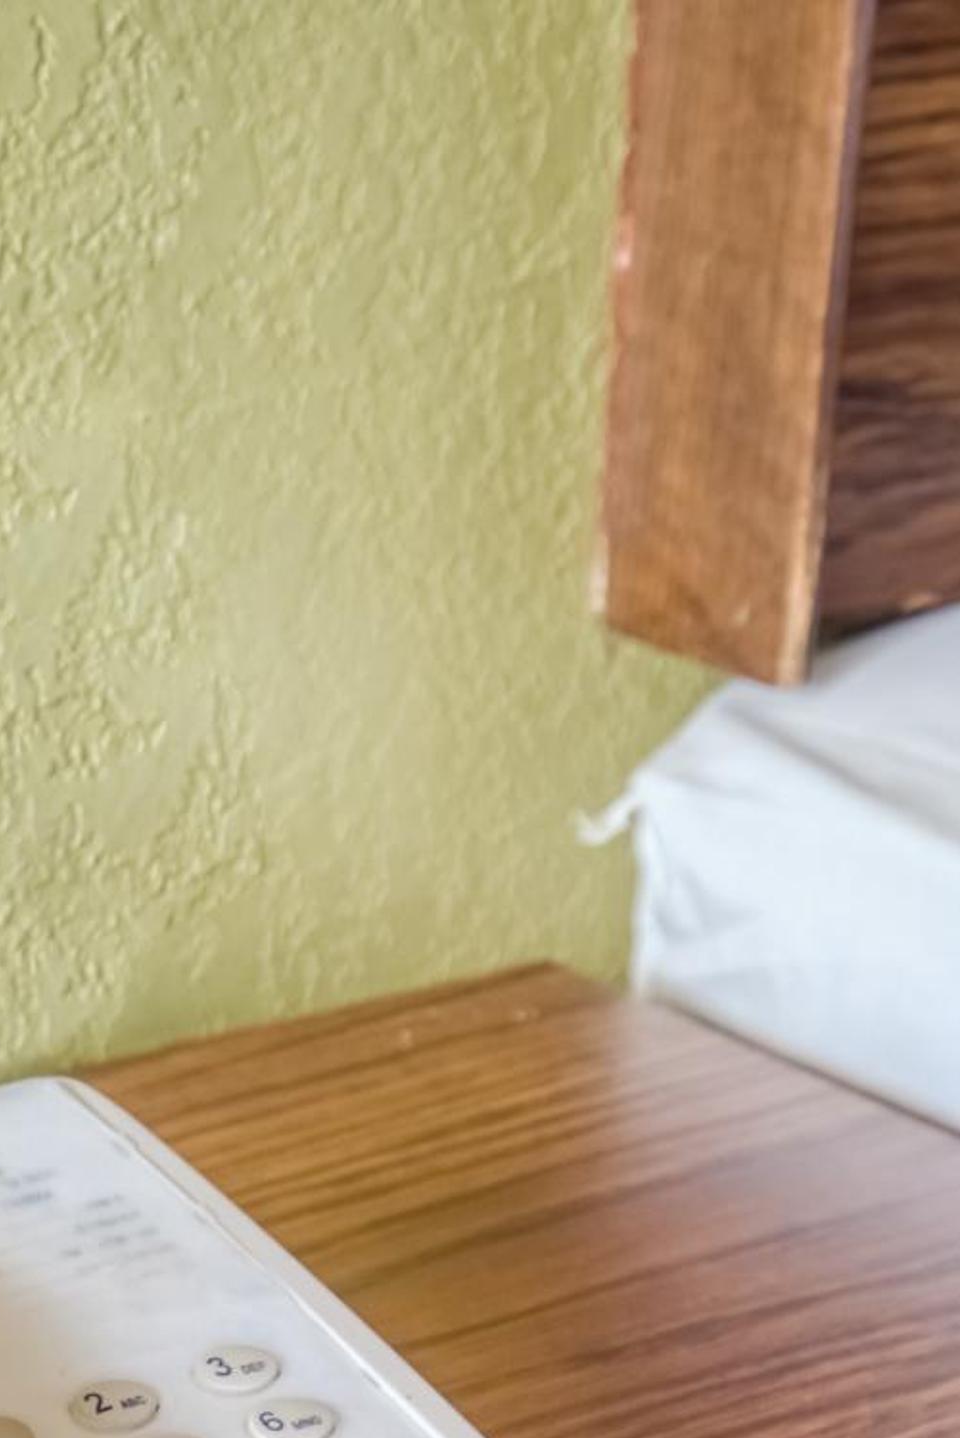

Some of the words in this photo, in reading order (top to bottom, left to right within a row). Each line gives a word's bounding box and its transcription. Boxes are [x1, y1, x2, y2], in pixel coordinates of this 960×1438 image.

[206, 1356, 232, 1377] 3
[84, 1392, 112, 1415] 2
[259, 1411, 284, 1432] 6
